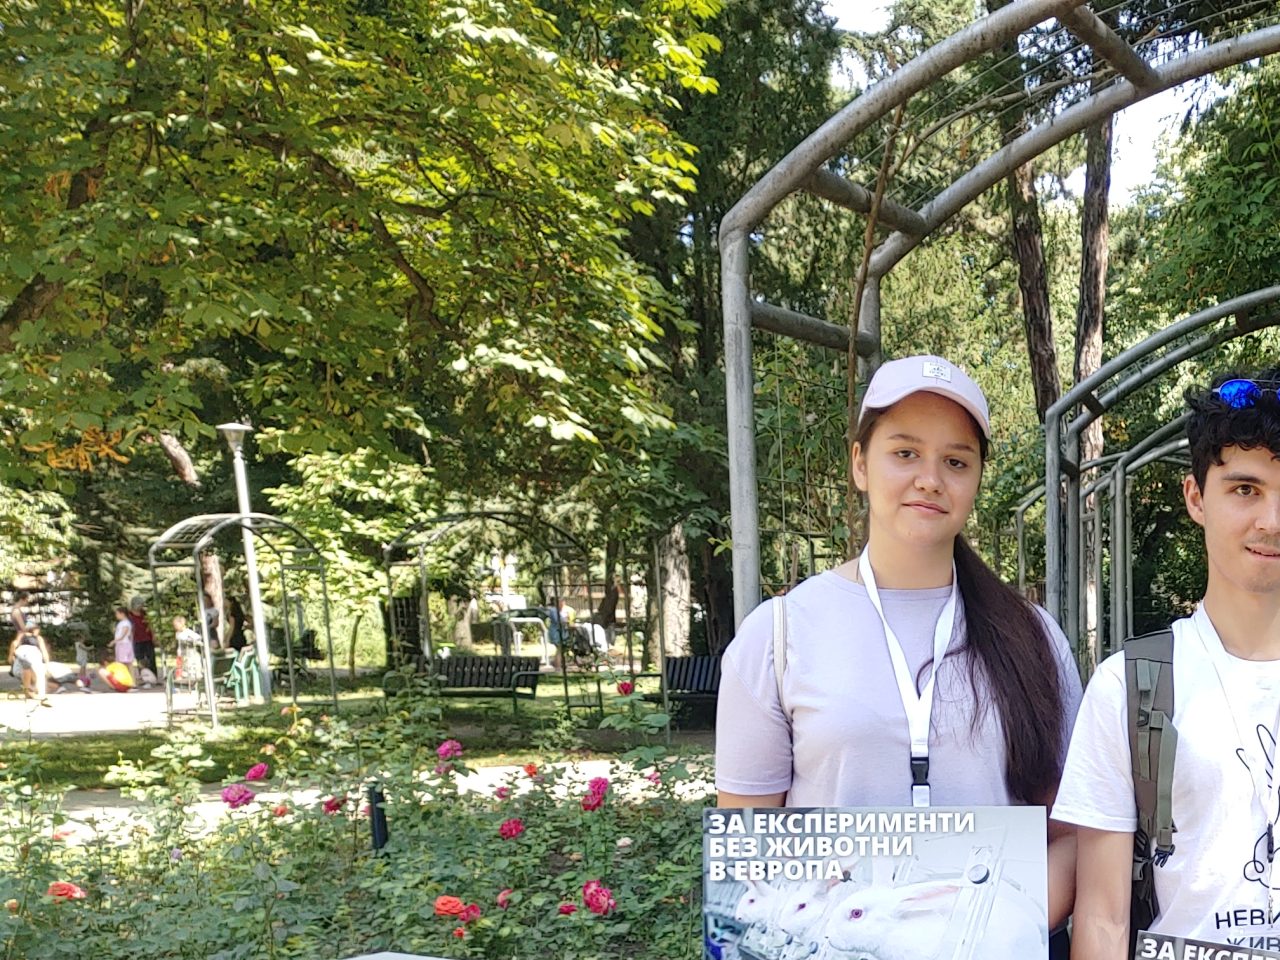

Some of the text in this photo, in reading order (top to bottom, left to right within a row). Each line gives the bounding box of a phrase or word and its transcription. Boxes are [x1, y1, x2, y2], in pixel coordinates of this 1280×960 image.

[709, 813, 974, 834] ЗА ЕКСПЕРИМЕНТИ
[709, 836, 912, 857] БЕЗ ЖИВОТНИ
[709, 860, 843, 880] В ЕВРОПА
